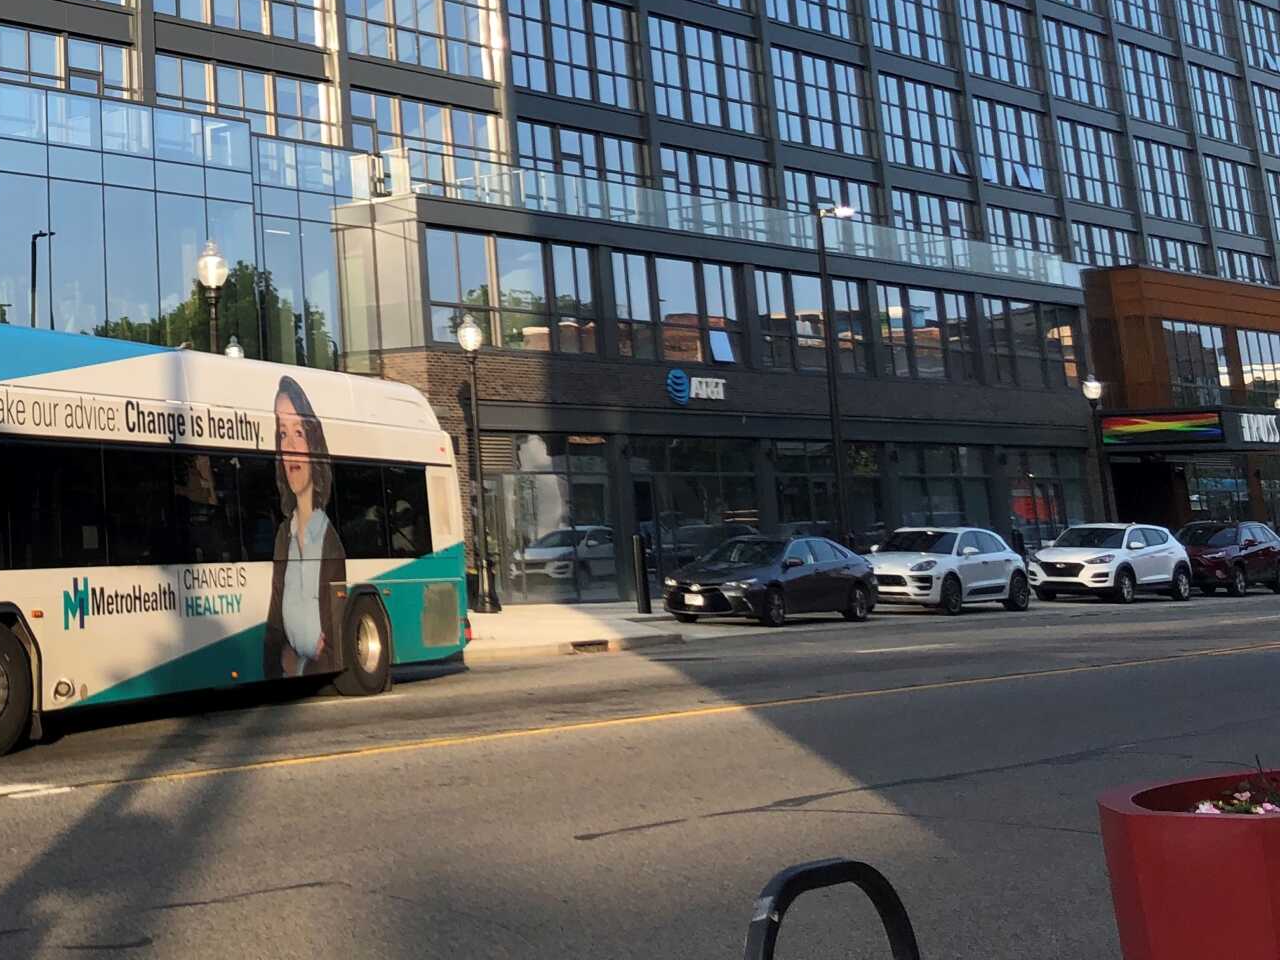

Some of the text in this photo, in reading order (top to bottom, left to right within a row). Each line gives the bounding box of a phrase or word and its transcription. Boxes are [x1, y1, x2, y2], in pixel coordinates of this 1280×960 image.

[690, 376, 727, 400] AT&T
[32, 400, 59, 428] our
[64, 396, 121, 433] advice:
[125, 400, 187, 444] Change
[189, 406, 205, 438] is
[207, 408, 265, 451] healthy.
[183, 566, 247, 590] CHANGE IS
[91, 583, 177, 617] MetroHealth
[185, 594, 242, 617] HEALTHY
